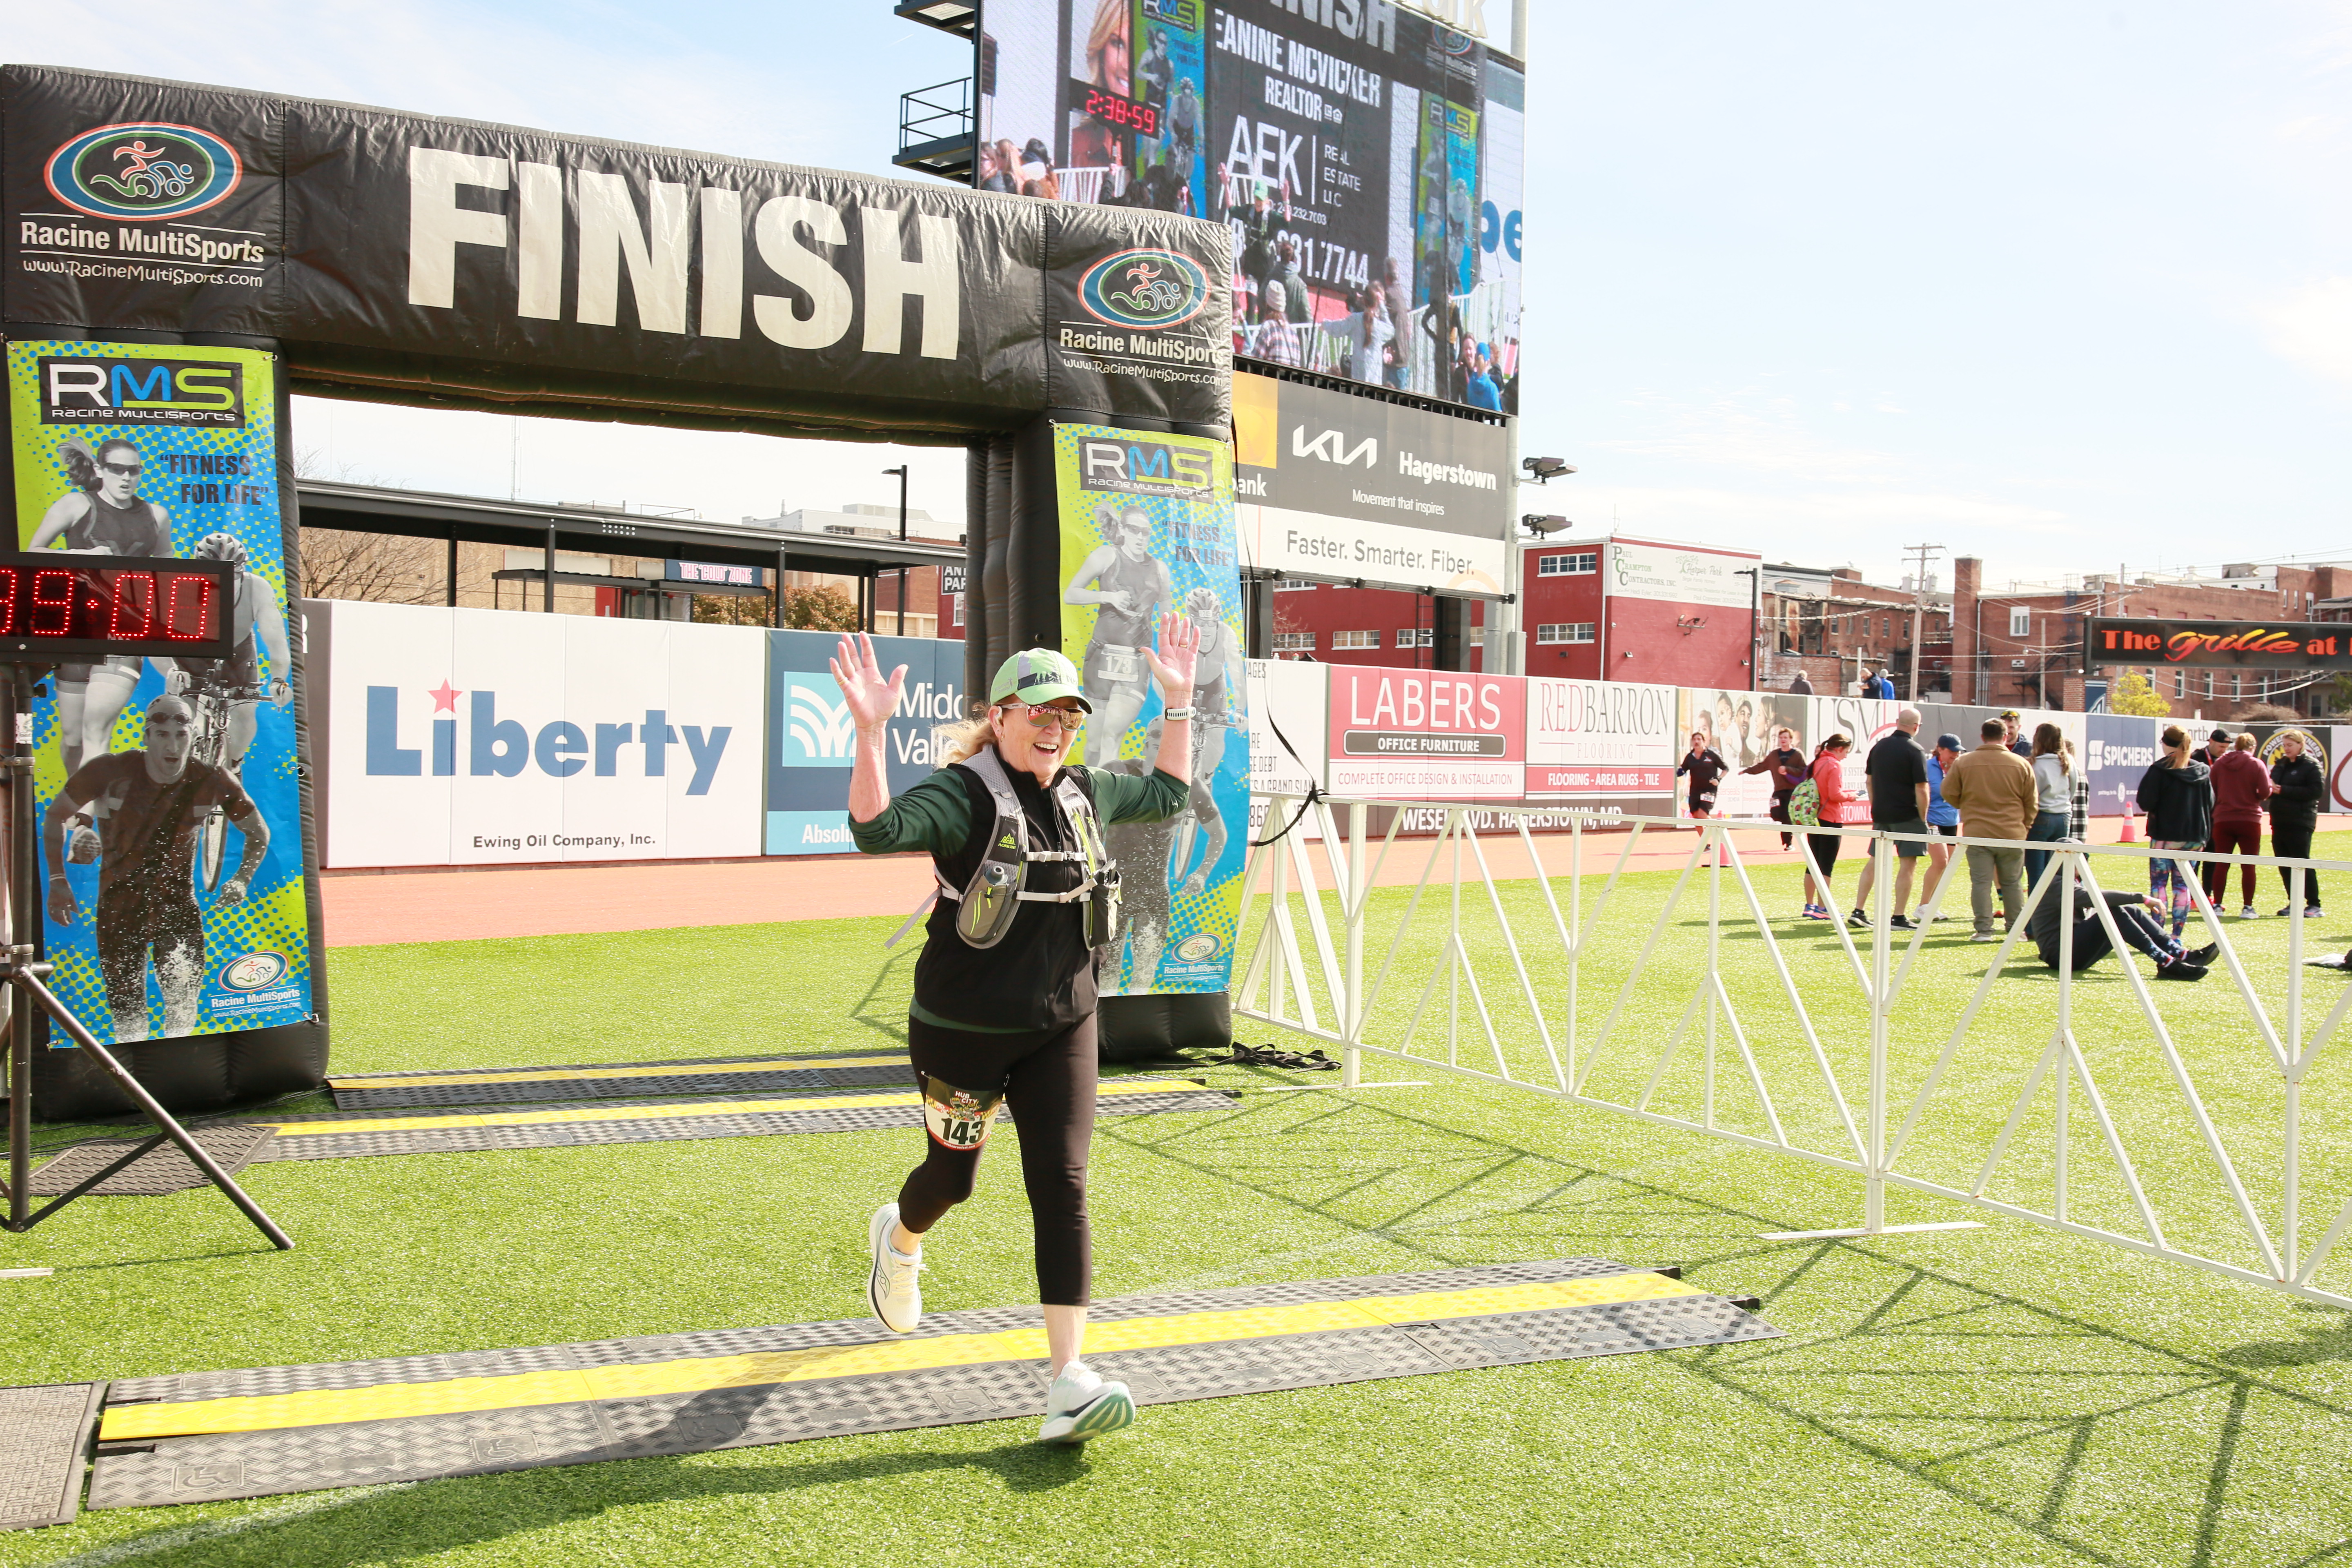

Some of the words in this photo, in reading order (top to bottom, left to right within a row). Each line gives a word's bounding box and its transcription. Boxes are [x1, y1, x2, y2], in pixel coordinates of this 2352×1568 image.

[1288, 40, 1380, 108] MCVICKER
[1265, 76, 1322, 122] REALTOR
[1225, 115, 1302, 196] AEK
[1324, 167, 1361, 191] ESTATE
[22, 222, 110, 249] Racine
[119, 227, 264, 263] MultiSports
[408, 146, 960, 360] FINISH
[23, 260, 263, 287] www.RacineMultiSports.com
[1060, 329, 1125, 352] Racine
[1130, 335, 1223, 365] MultiSports
[49, 363, 235, 411] RMS
[1086, 443, 1208, 489] RMS
[1399, 451, 1497, 490] Hagerstown
[181, 483, 219, 503] FOR
[1352, 489, 1396, 508] Movement
[1398, 495, 1414, 510] that
[1415, 498, 1444, 515] inspires
[1176, 545, 1200, 563] FOR
[1287, 530, 1348, 560] Faster.
[1354, 539, 1425, 570] Smarter.
[1431, 549, 1474, 575] Fiber.
[679, 563, 699, 579] THE
[728, 567, 752, 584] ZONE
[2101, 630, 2161, 650] The
[2307, 636, 2338, 655] at
[1105, 656, 1132, 674] 173
[1351, 676, 1501, 730] LABERS
[366, 678, 733, 795] Liberty
[1378, 737, 1417, 751] OFFICE
[1420, 738, 1480, 753] FURNITURE
[1577, 743, 1633, 759] FLOORING
[2104, 746, 2153, 767] SPICHERS
[1258, 756, 1277, 772] DEBT
[1338, 772, 1385, 785] COMPLETE
[1388, 772, 1417, 785] OFFICE
[1418, 773, 1448, 785] DESIGN
[1451, 773, 1457, 784] &
[1459, 773, 1512, 785] INSTALLATION
[1548, 773, 1589, 786] FLOORING
[1595, 774, 1617, 786] AREA
[1618, 774, 1639, 786] RUGS
[1644, 774, 1659, 786] TILE
[1600, 806, 1623, 826] MD
[473, 835, 520, 850] Ewing
[527, 834, 547, 848] Oil
[552, 834, 625, 850] Company,
[630, 833, 656, 845] Inc.
[1188, 964, 1224, 972] MultiSports
[211, 997, 245, 1007] Racine
[247, 989, 300, 1003] MultiSports
[941, 1118, 986, 1145] 143
